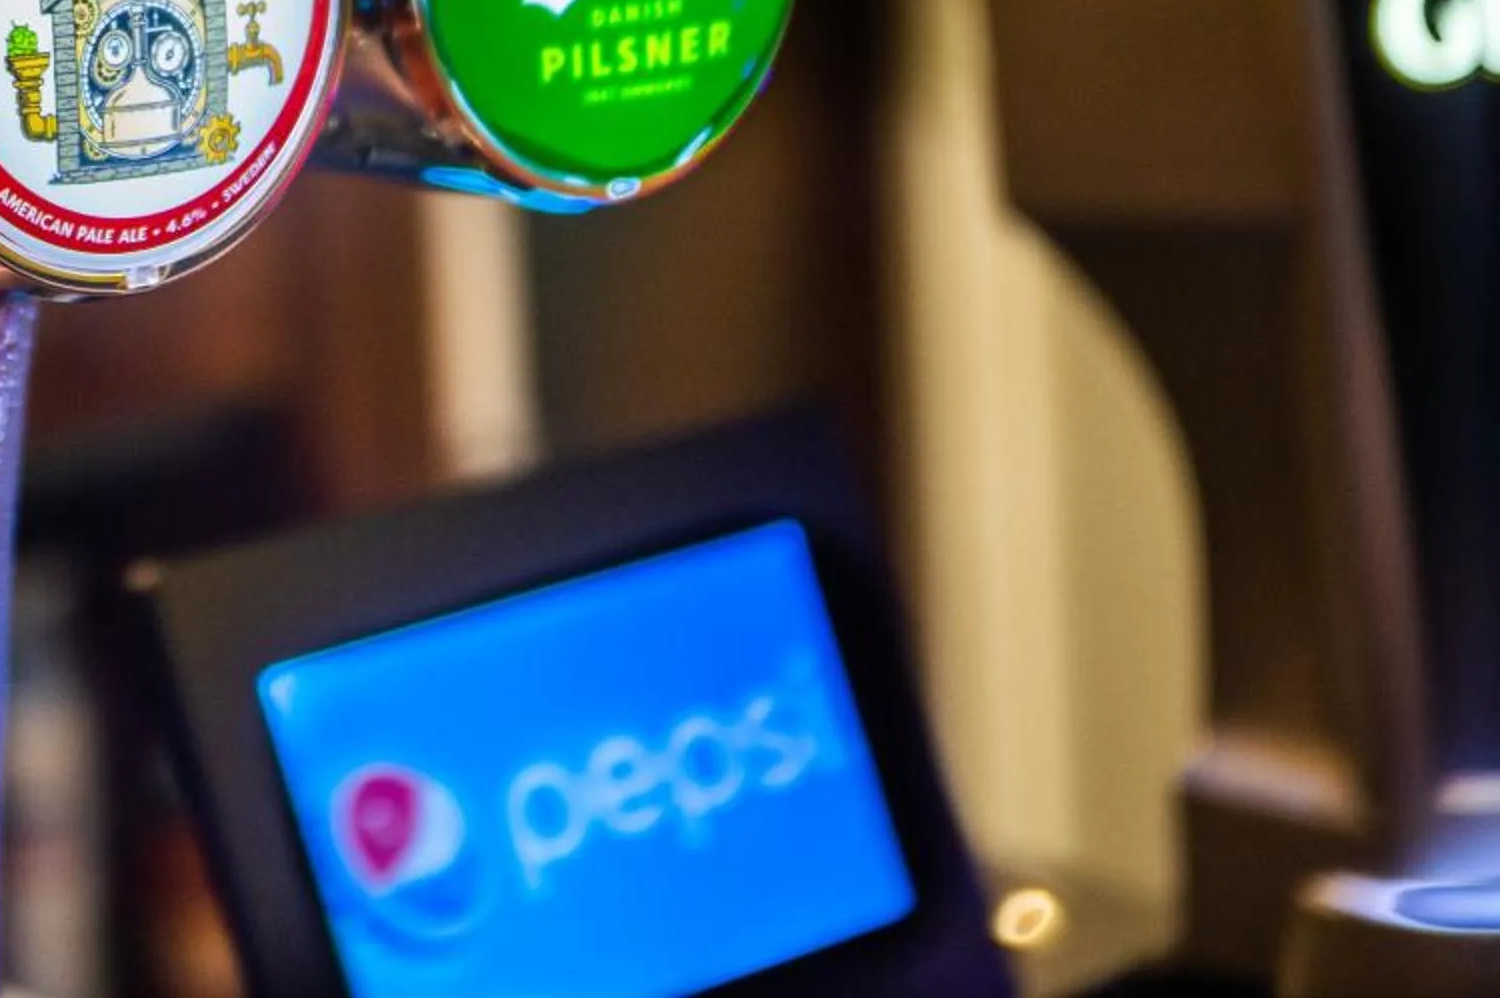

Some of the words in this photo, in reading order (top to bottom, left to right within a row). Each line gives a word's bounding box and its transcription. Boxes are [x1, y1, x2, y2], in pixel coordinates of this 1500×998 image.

[540, 21, 731, 83] PILSNER
[76, 225, 113, 245] PALE
[119, 226, 148, 244] ALE
[222, 142, 278, 203] SWEDEN
